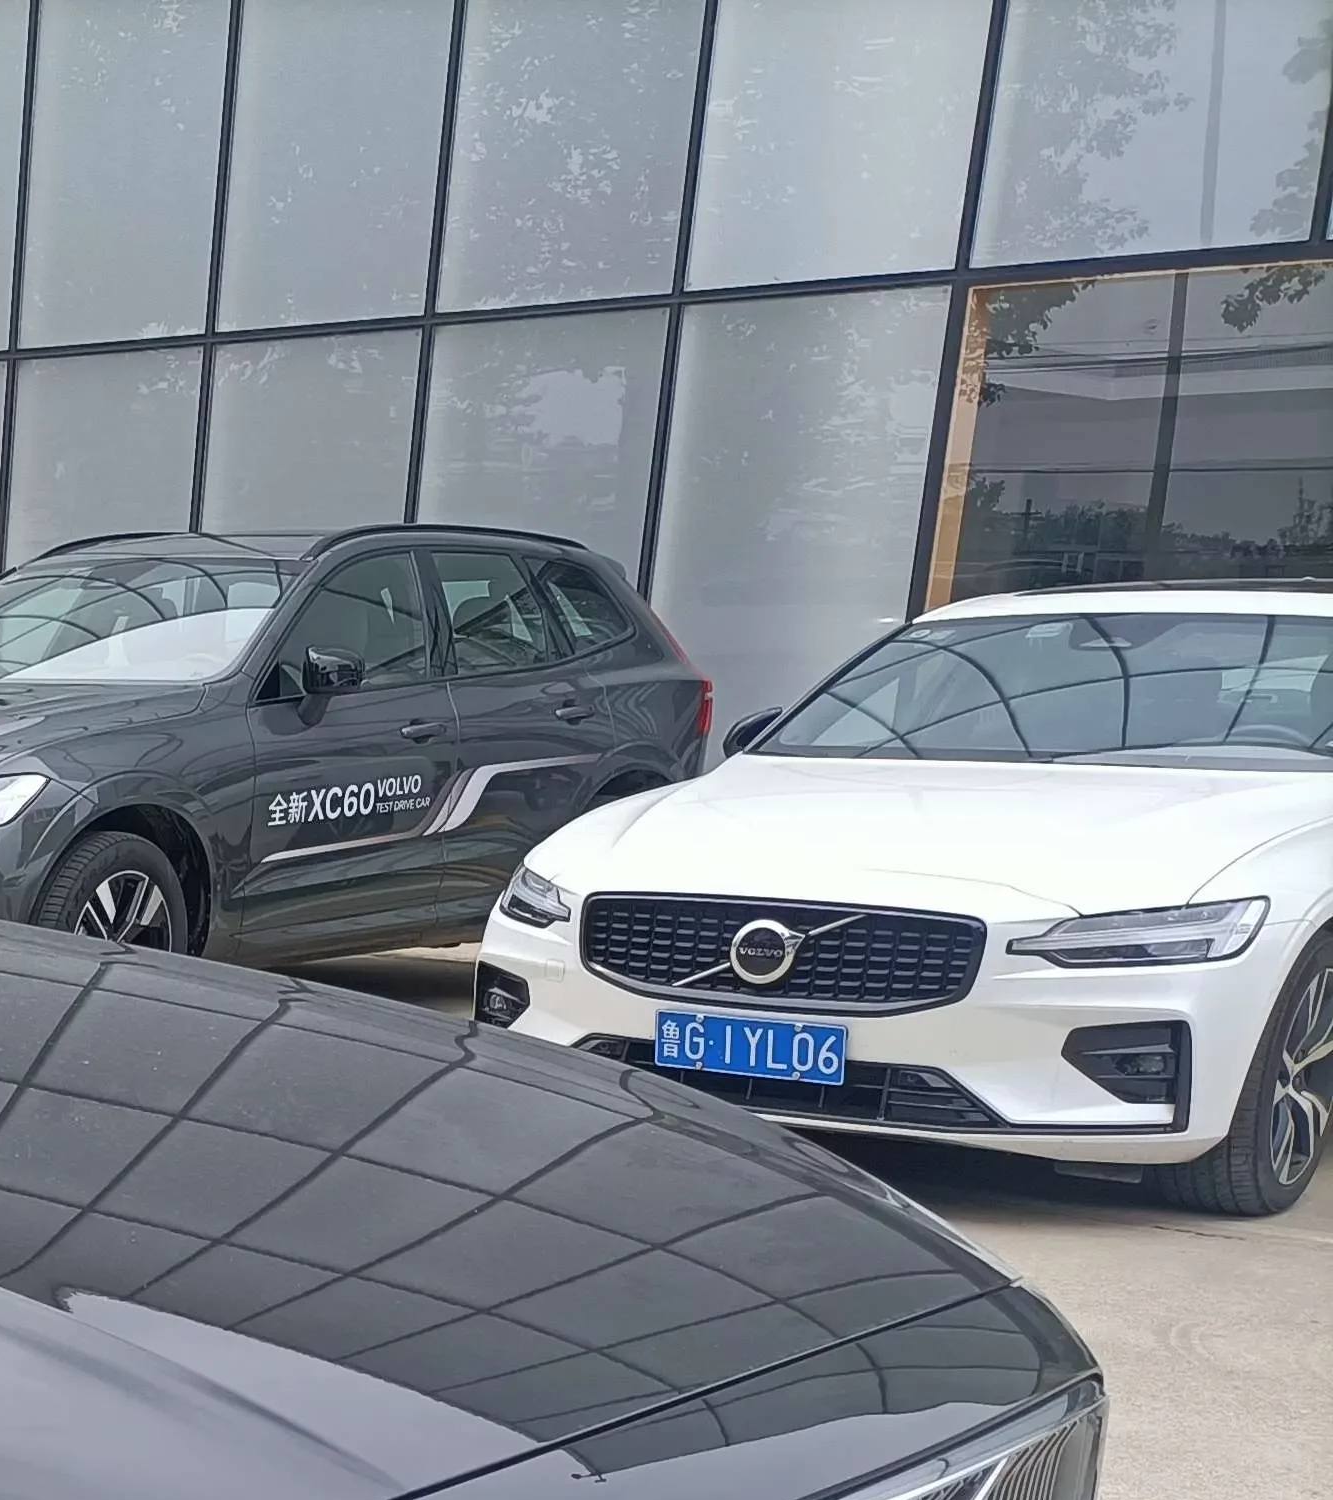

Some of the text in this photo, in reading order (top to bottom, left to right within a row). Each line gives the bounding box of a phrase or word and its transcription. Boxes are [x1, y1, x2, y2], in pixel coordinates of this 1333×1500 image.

[377, 774, 422, 798] VOLVO
[376, 796, 431, 814] TEST DRIVE CAR
